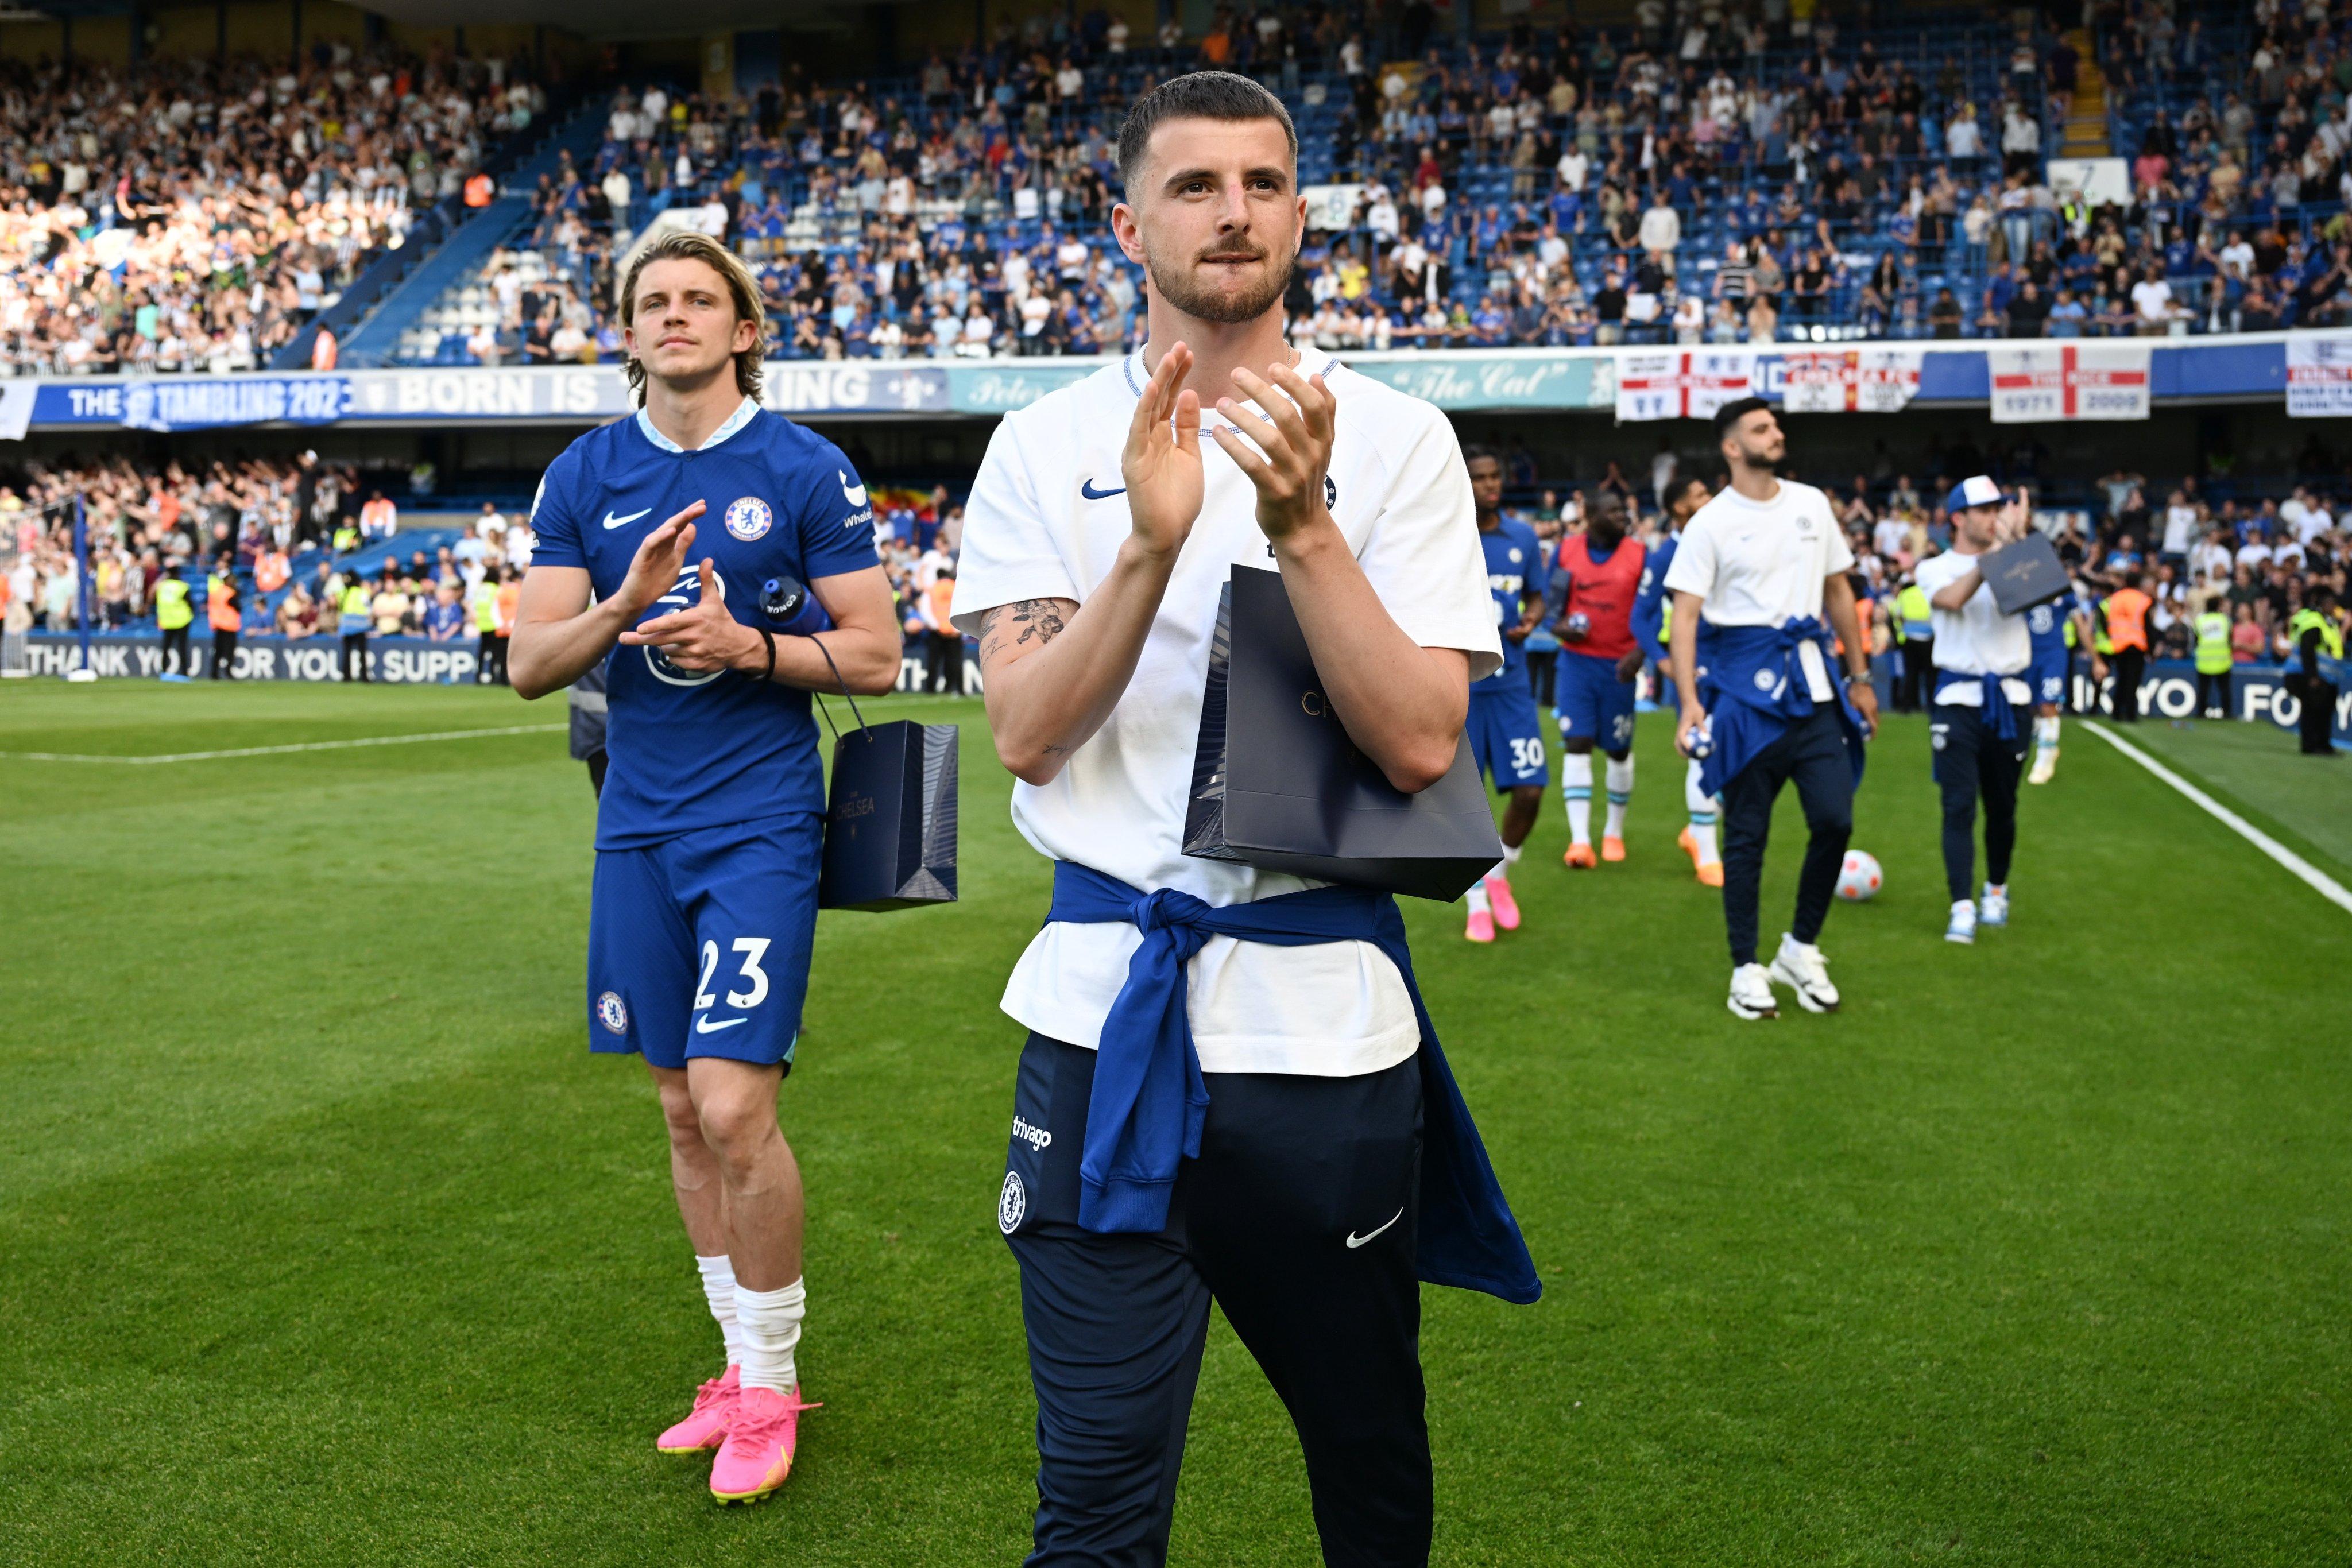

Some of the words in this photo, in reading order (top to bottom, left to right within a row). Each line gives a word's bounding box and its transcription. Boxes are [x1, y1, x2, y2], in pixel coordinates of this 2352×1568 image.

[68, 389, 121, 416] THE
[156, 380, 286, 422] TAMBLING
[288, 378, 339, 418] 202
[397, 373, 534, 412] BORN
[548, 374, 597, 413] IS
[844, 506, 872, 528] Whale
[767, 594, 796, 614] CONOR
[25, 644, 130, 677] THANK
[135, 645, 202, 678] YOU
[283, 648, 376, 682] YOUR
[382, 649, 493, 683] SUPP
[2134, 677, 2223, 719] YO
[2243, 683, 2303, 727] FO
[1509, 737, 1545, 769] 30
[693, 937, 771, 1009] 23
[1012, 1115, 1052, 1152] trivago
